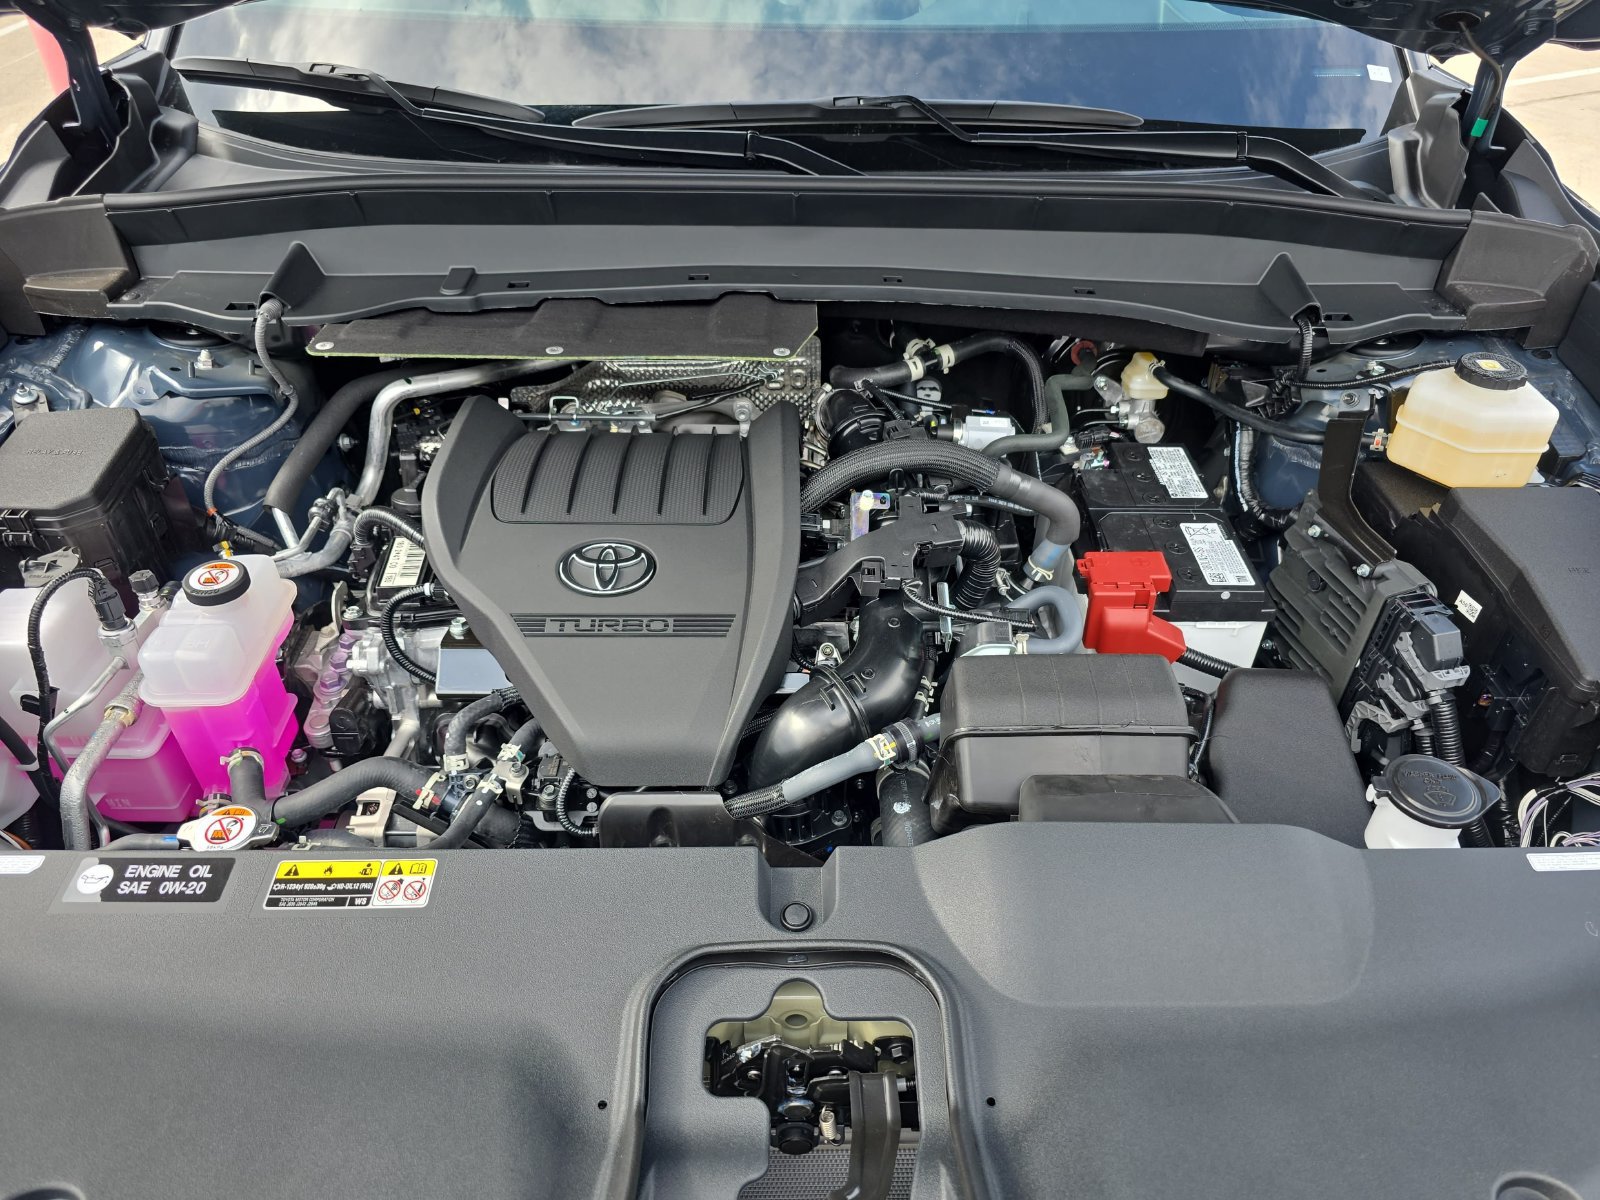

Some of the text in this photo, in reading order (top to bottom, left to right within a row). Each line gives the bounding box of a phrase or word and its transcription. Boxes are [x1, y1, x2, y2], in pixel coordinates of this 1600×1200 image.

[549, 618, 670, 633] TURBO
[125, 865, 213, 878] ENGINE OIL
[117, 881, 207, 895] SAE 0W-20
[354, 897, 367, 905] WS
